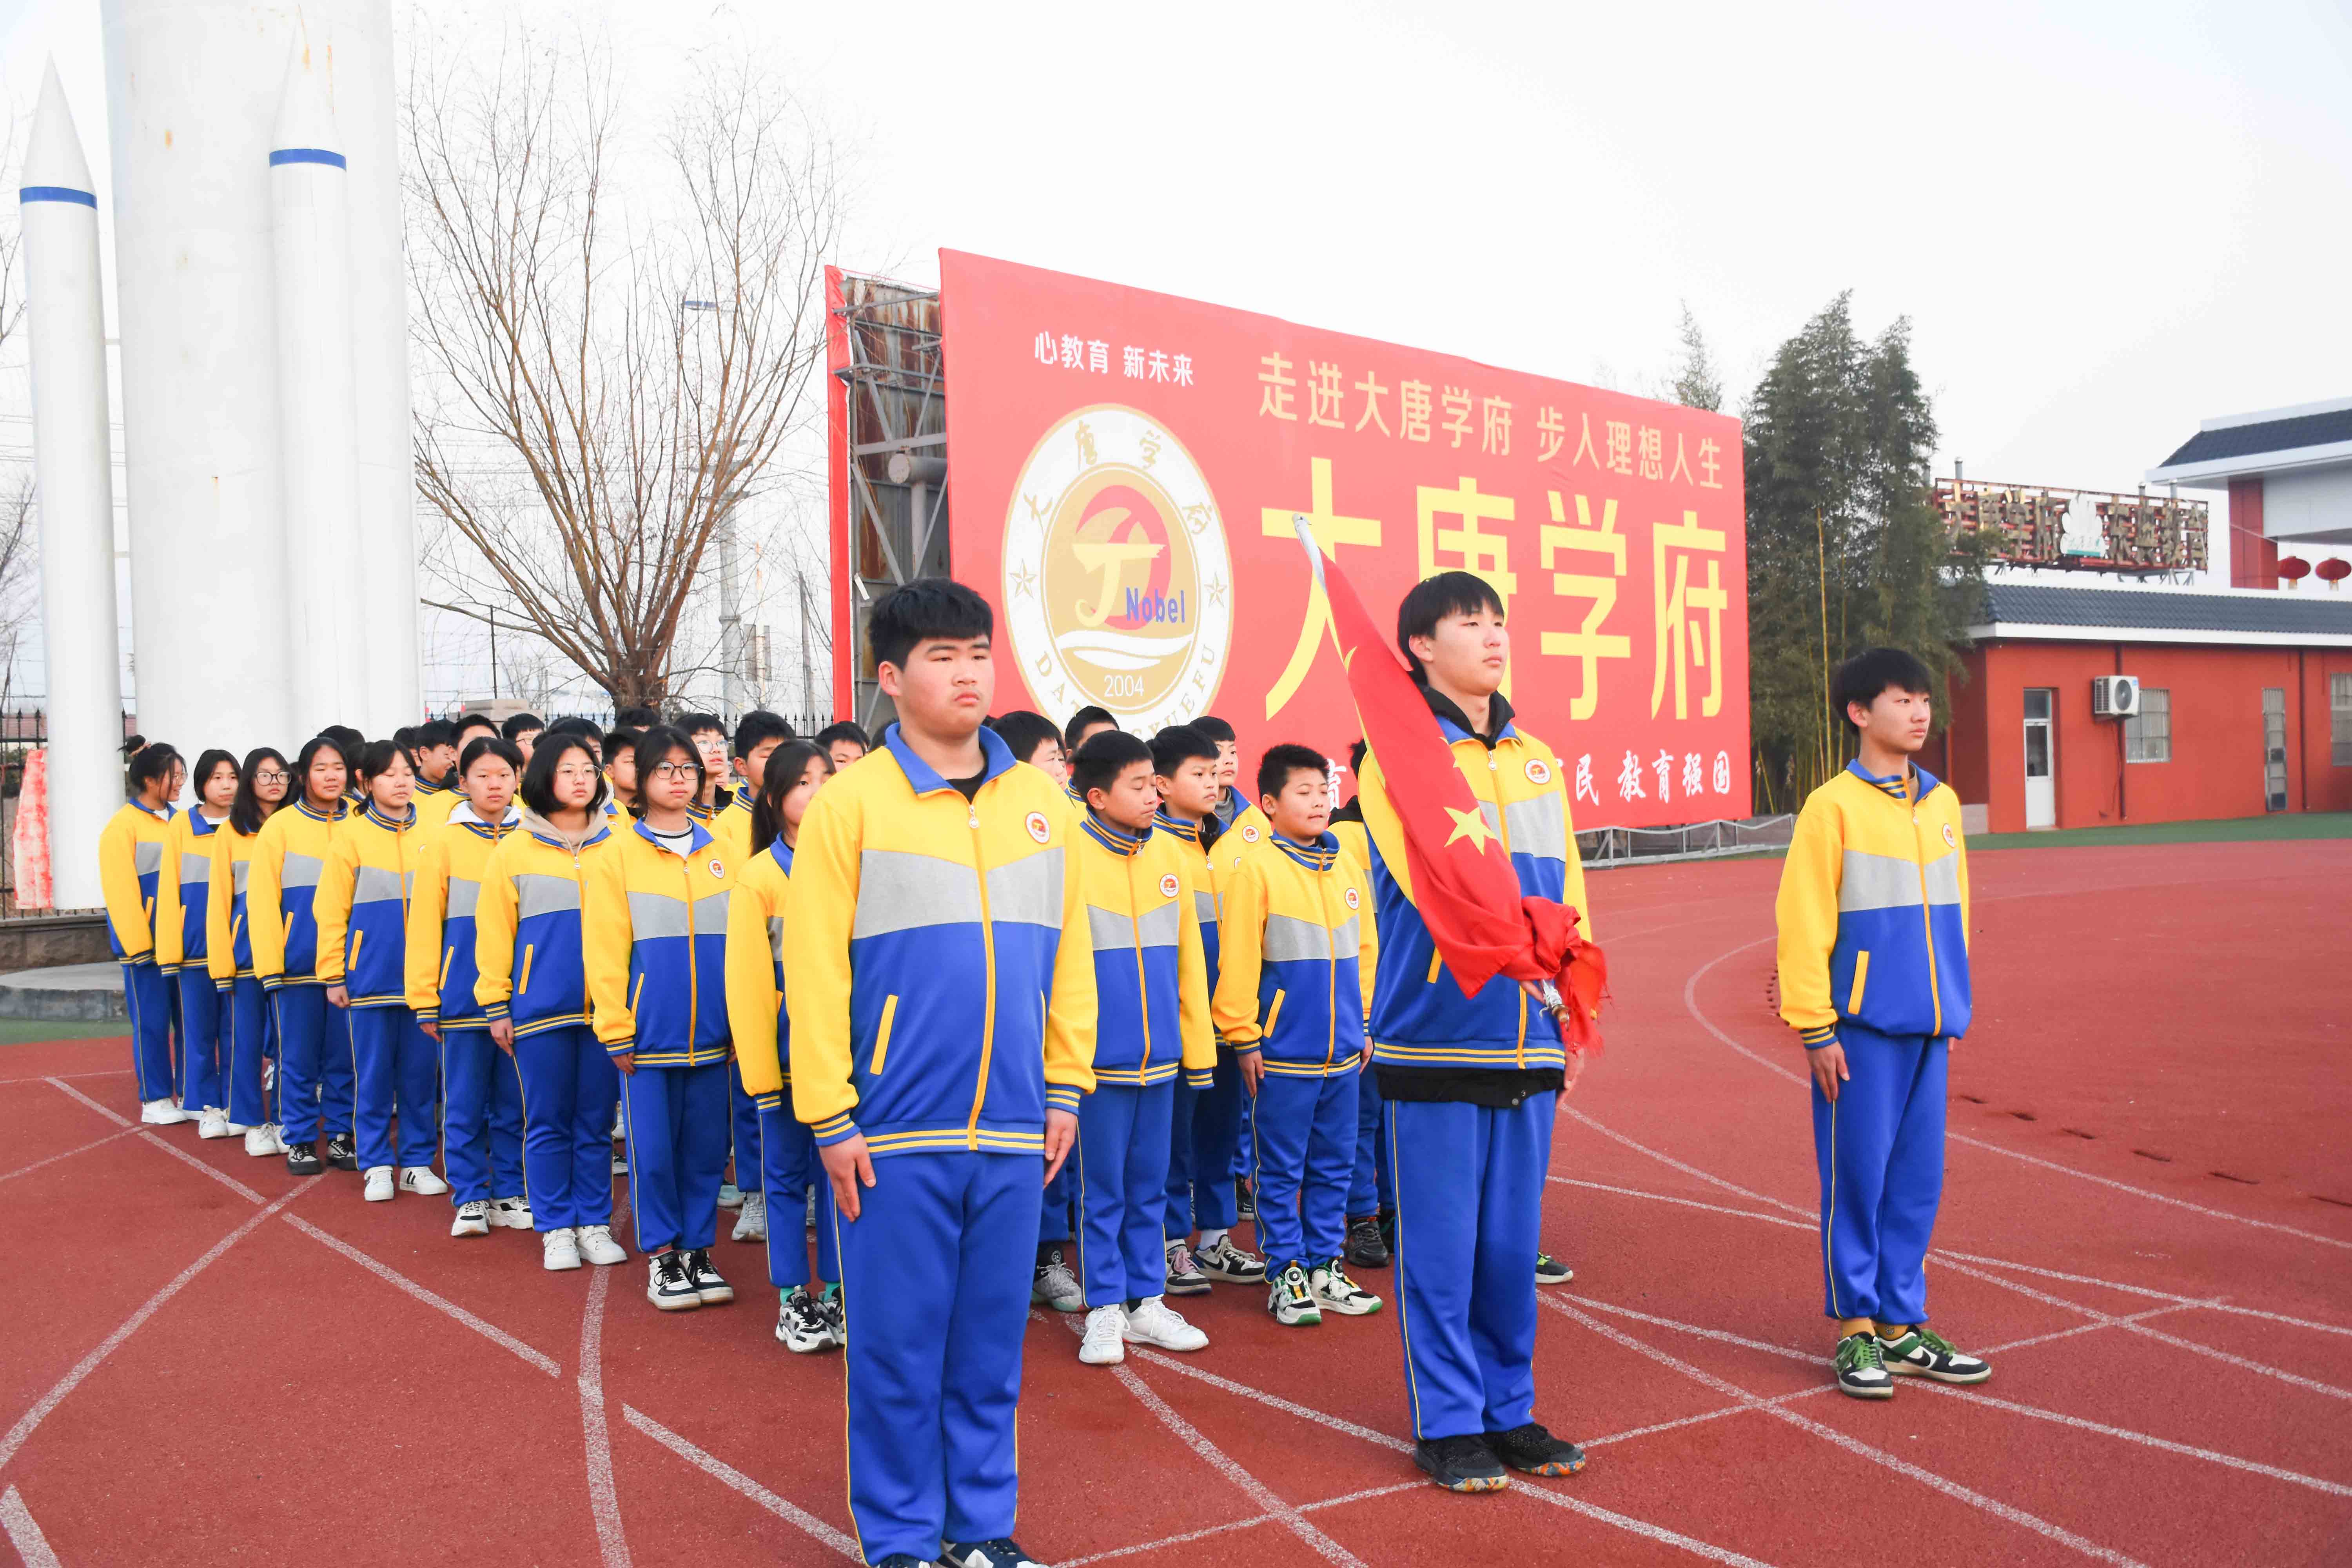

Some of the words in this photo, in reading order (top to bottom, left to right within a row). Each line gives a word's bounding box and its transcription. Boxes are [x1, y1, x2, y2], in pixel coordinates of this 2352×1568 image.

[1034, 330, 1109, 374] 心教育
[1123, 345, 1194, 387] 新未来
[1258, 352, 1512, 456] 走进大唐学府
[1125, 586, 1186, 624] Nobel
[1103, 674, 1145, 697] 2004
